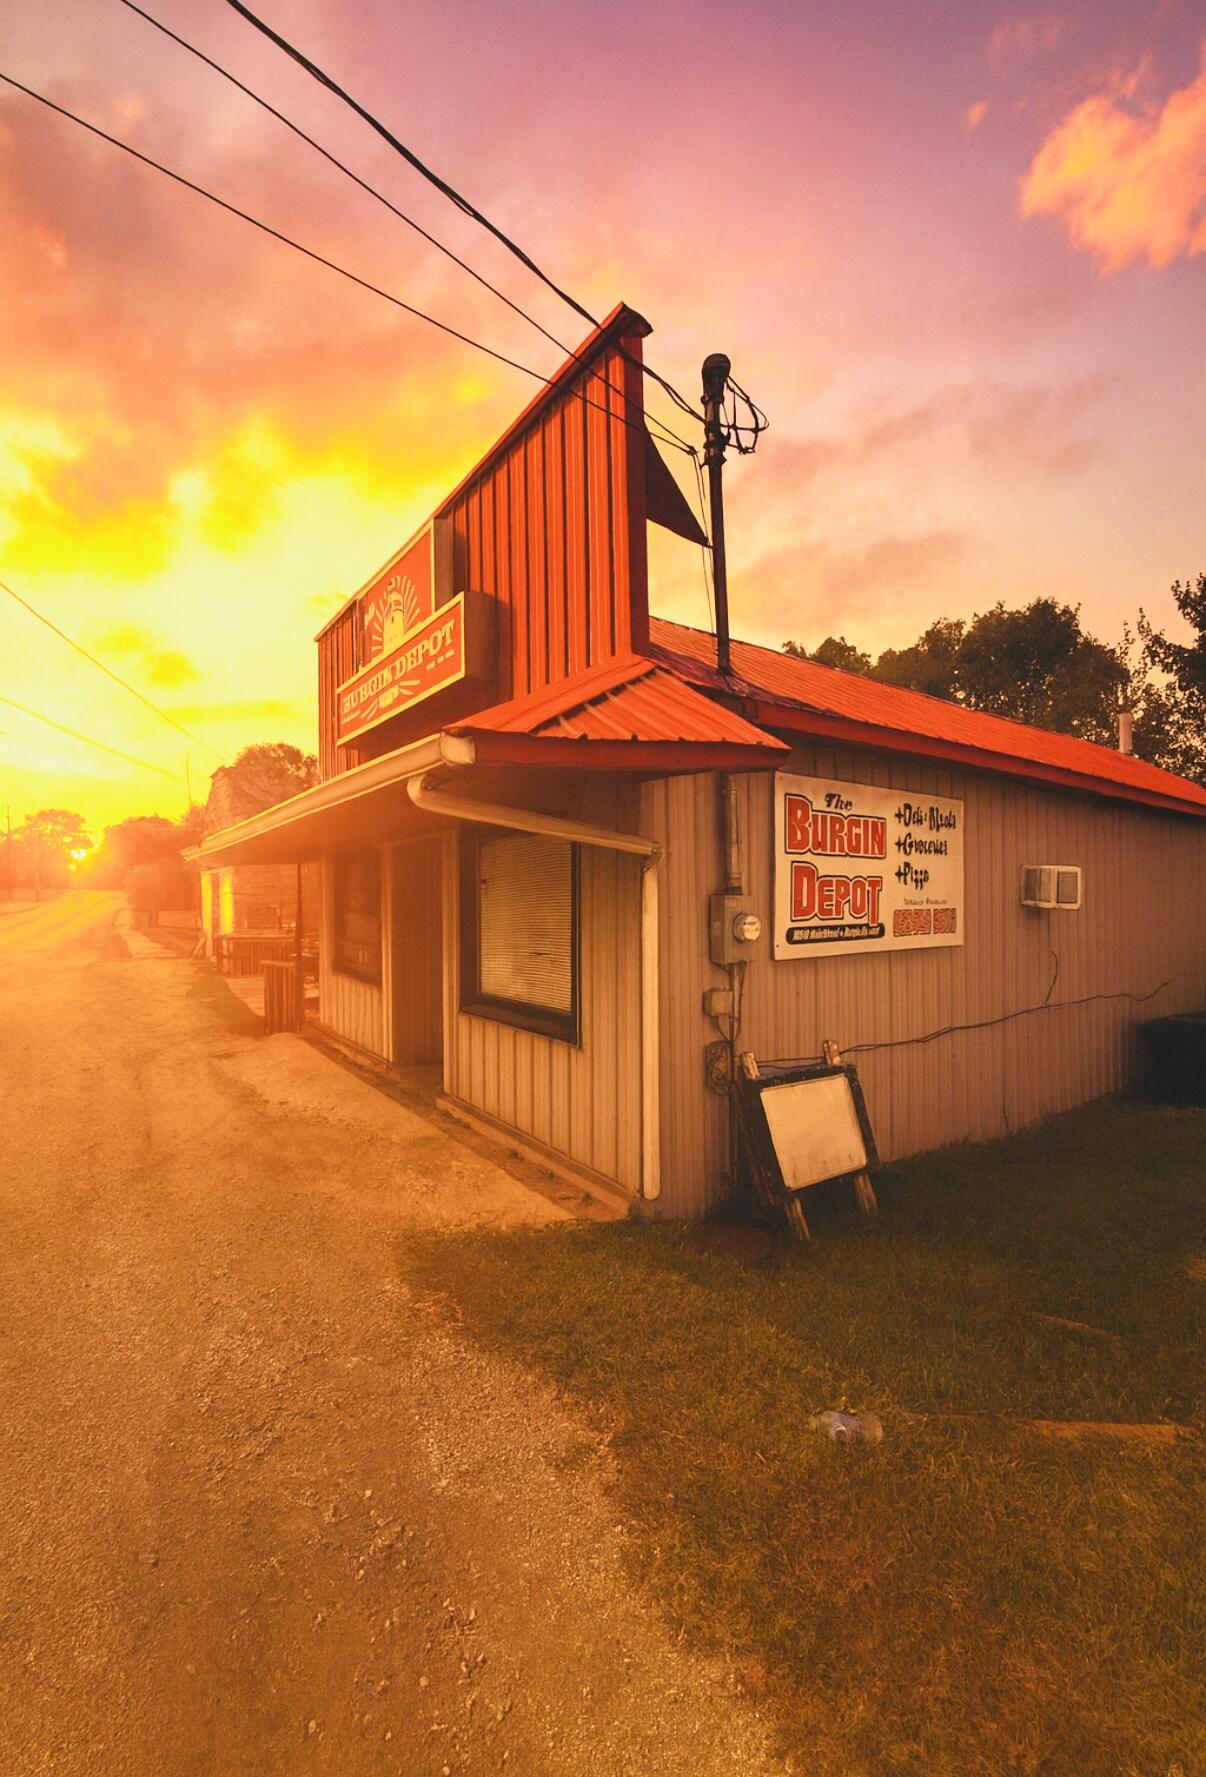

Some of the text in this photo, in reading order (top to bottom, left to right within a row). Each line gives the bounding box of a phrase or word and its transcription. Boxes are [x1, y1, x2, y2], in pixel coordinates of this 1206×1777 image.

[393, 619, 455, 680] DEPOT
[785, 793, 887, 859] BURGIN
[824, 793, 853, 811] The
[791, 861, 882, 927] DEPOT
